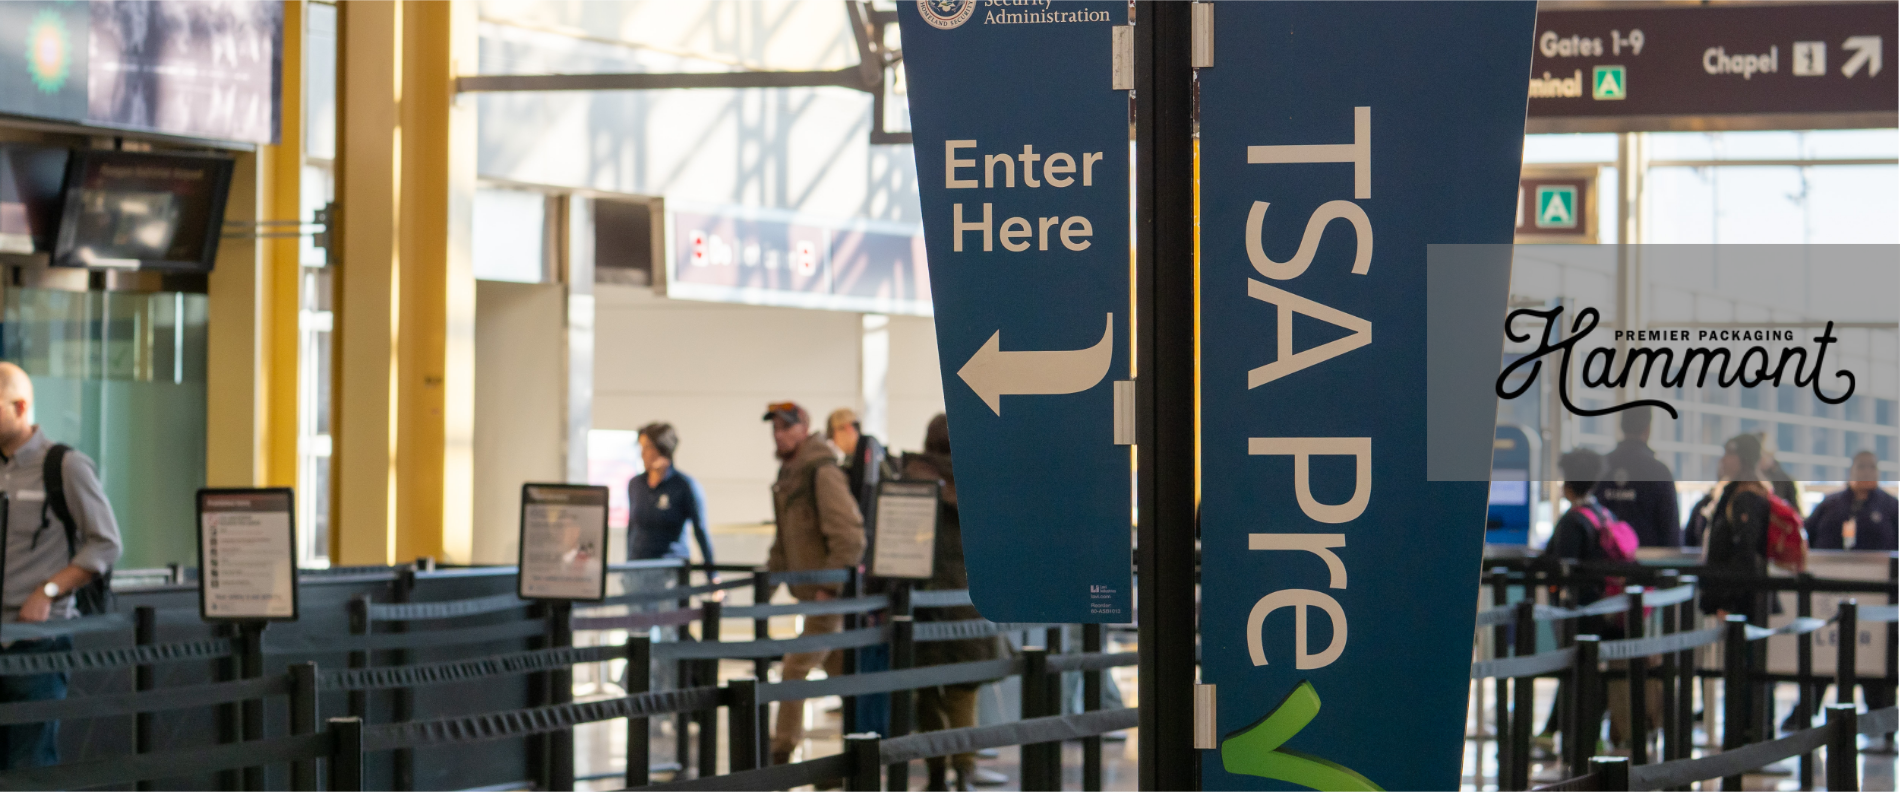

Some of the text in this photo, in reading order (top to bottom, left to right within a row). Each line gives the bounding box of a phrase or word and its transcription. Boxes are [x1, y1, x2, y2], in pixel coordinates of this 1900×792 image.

[920, 0, 973, 27] HOMELAND SECURITY
[983, 7, 1111, 25] Administration
[1539, 29, 1645, 57] Gates 1-9
[1702, 45, 1779, 80] Chapel
[1529, 68, 1624, 98] minal A
[945, 139, 1103, 189] Enter
[953, 202, 1094, 252] Here
[1245, 106, 1374, 670] TSA Pre
